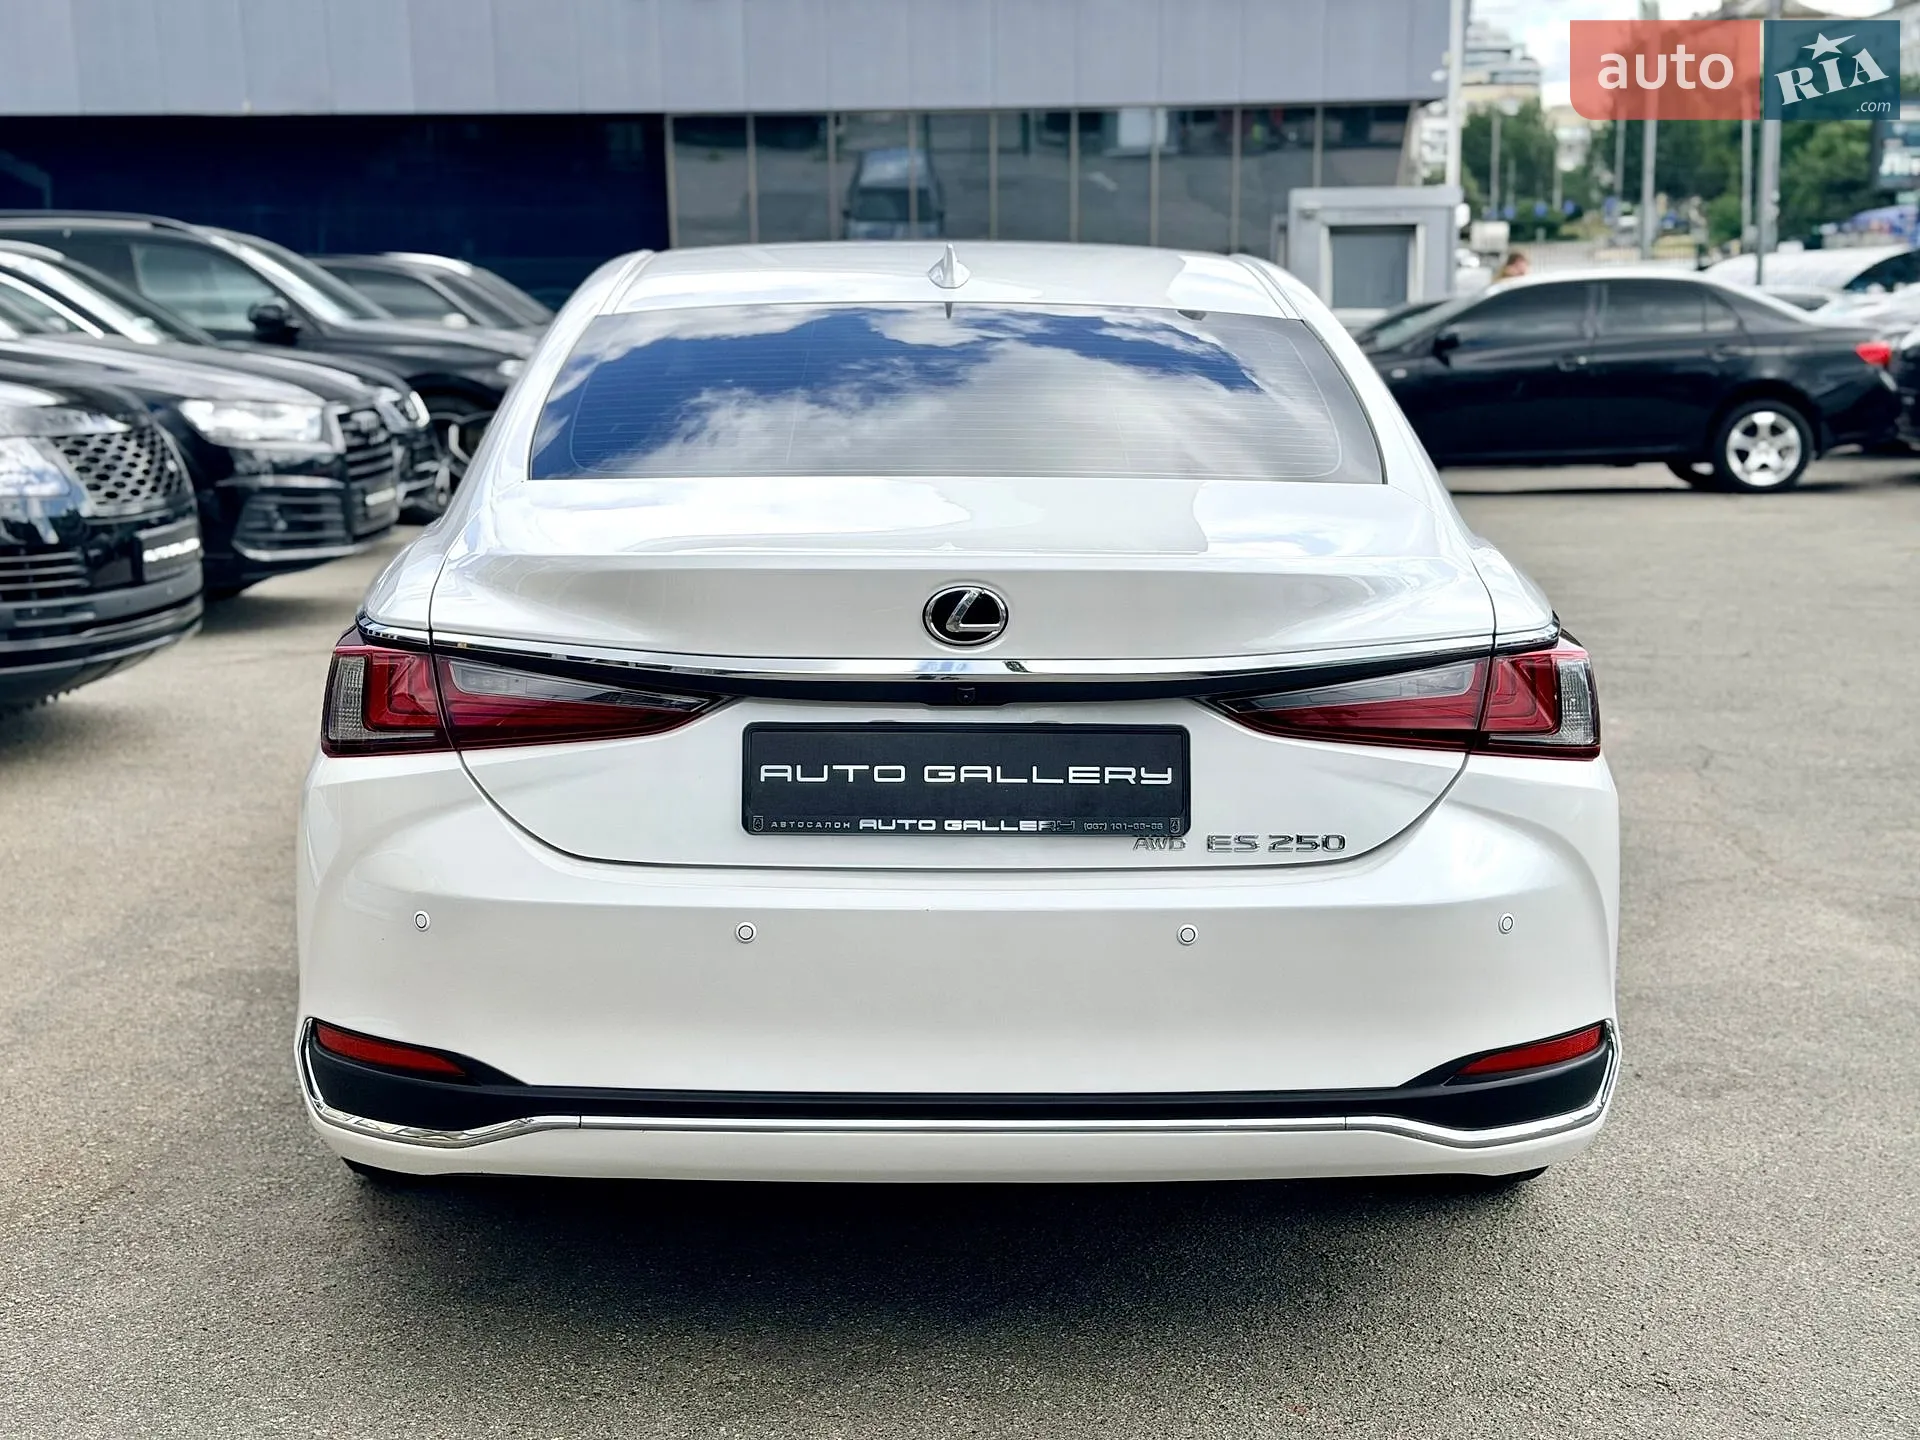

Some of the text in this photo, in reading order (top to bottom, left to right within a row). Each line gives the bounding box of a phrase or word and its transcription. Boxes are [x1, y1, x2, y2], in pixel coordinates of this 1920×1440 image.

[760, 764, 1173, 785] AUTO GALLERY
[770, 820, 851, 829] АВТОСАЛОН
[858, 818, 937, 831] AUTO
[1132, 834, 1346, 852] AWD ES 250
